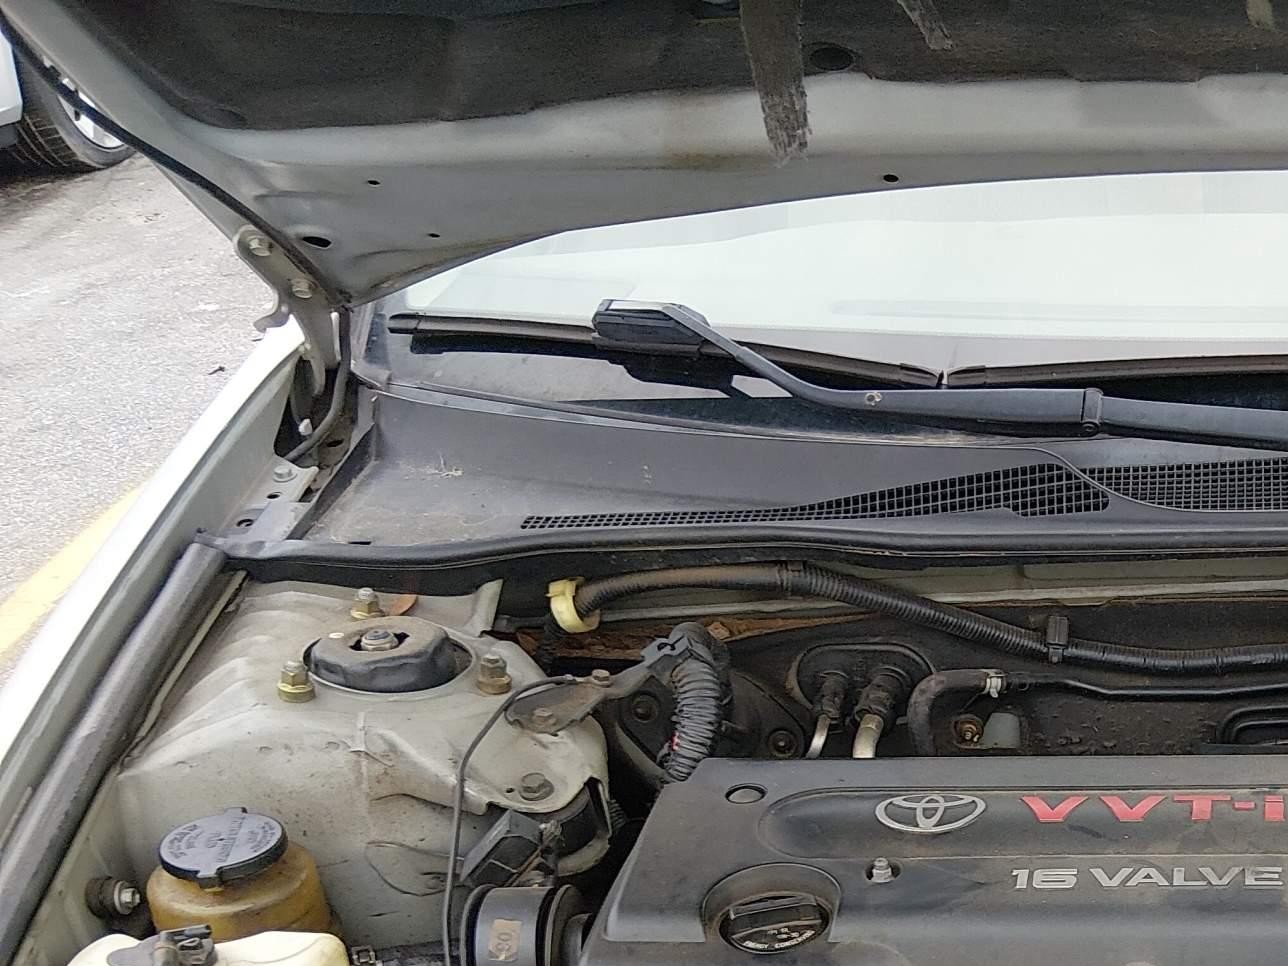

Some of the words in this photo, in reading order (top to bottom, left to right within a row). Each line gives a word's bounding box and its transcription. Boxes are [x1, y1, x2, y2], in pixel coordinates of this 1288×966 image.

[1021, 794, 1286, 823] VVT-i
[1011, 868, 1078, 889] 16
[1088, 866, 1285, 888] VALVE
